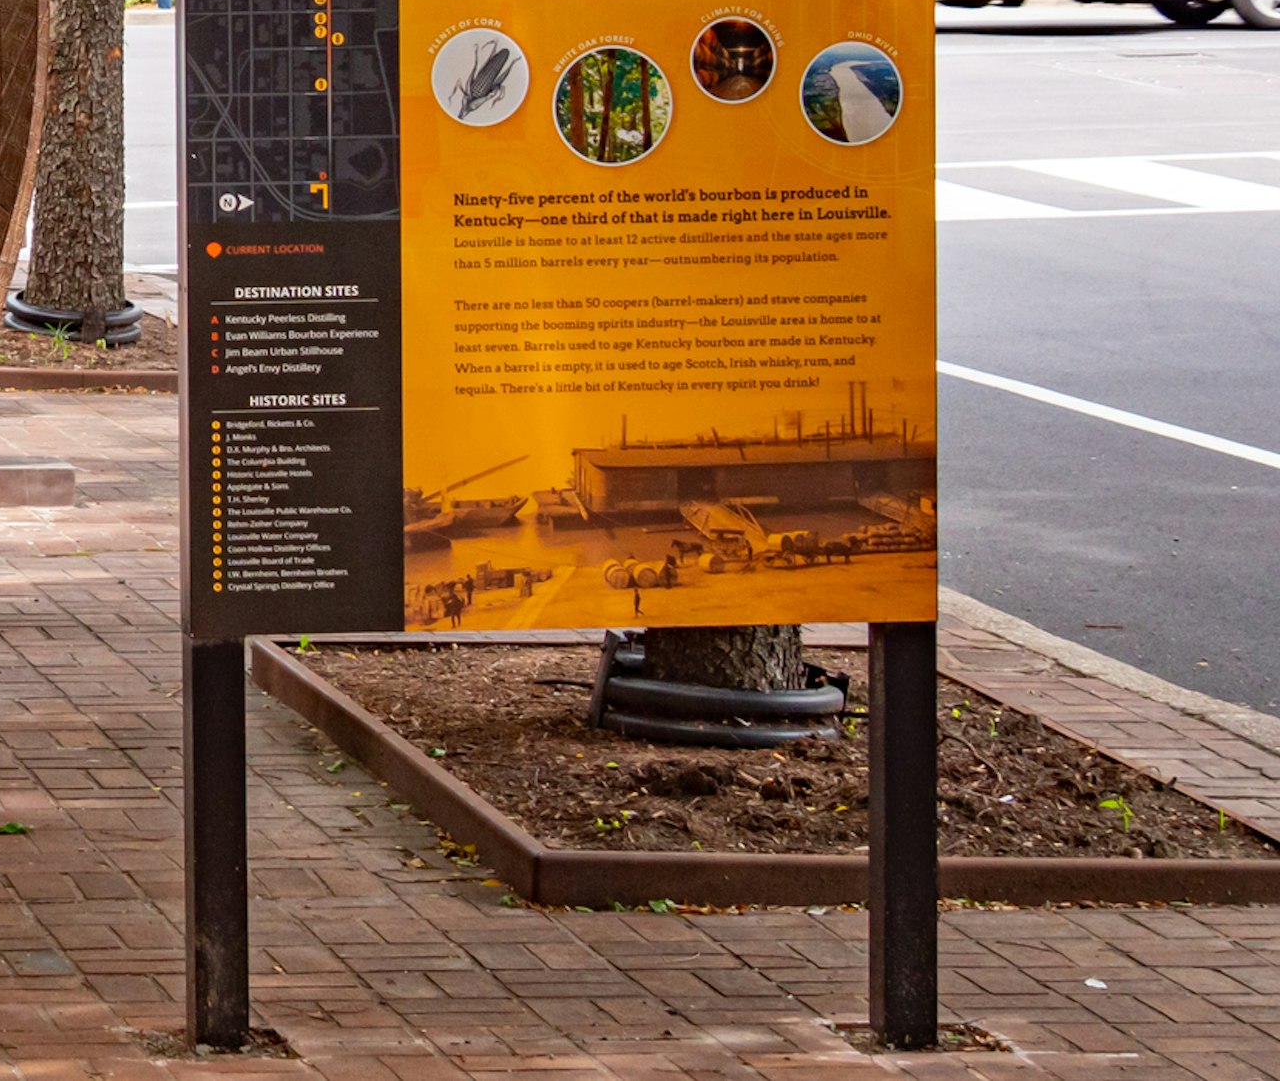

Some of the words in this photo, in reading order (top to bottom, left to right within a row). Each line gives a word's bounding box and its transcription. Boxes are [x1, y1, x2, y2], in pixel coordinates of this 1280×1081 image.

[700, 6, 742, 23] CLIMATE
[744, 7, 763, 20] FOR
[762, 19, 784, 48] AGING
[428, 25, 457, 54] PLENTY
[458, 19, 471, 28] OF
[473, 17, 503, 28] CORN
[847, 30, 874, 41] OHIO
[875, 36, 898, 57] RIVER
[553, 47, 578, 72] WHITE
[578, 38, 598, 50] OAK
[599, 35, 635, 45] FOREST
[454, 192, 534, 209] Ninety-five
[538, 193, 595, 207] percent
[598, 190, 614, 203] of
[616, 191, 640, 203] the
[644, 189, 696, 202] world's
[699, 188, 762, 201] bourbon
[765, 187, 777, 200] is
[780, 185, 850, 203] produced
[854, 185, 868, 198] in
[454, 213, 568, 229] Kentucky—one
[572, 212, 608, 225] third
[612, 211, 627, 224] of
[630, 211, 658, 223] that
[662, 211, 674, 223] is
[678, 209, 718, 223] made
[722, 209, 757, 225] right
[762, 209, 794, 221] here
[798, 208, 813, 220] in
[817, 206, 891, 220] Louisville.
[226, 245, 271, 255] CURRENT
[274, 244, 324, 254] LOCATION
[235, 286, 322, 299] DESTINATION
[325, 285, 358, 297] SITES
[211, 316, 219, 324] A
[225, 315, 266, 325] Kentucky
[268, 313, 306, 323] Peerless
[307, 313, 346, 324] Distilling
[212, 332, 218, 341] B
[225, 331, 248, 341] Evan
[248, 331, 287, 340] Williams
[288, 330, 328, 339] Bourbon
[330, 329, 379, 339] Experience
[212, 349, 218, 357] C
[225, 349, 240, 359] Jim
[242, 347, 268, 357] Beam
[270, 347, 298, 356] Urban
[300, 346, 344, 356] Stillhouse
[212, 365, 219, 373] D
[225, 364, 258, 375] Angel's
[259, 363, 281, 375] Envy
[282, 363, 322, 374] Distillery
[250, 395, 309, 407] HISTORIC
[312, 394, 346, 405] SITES
